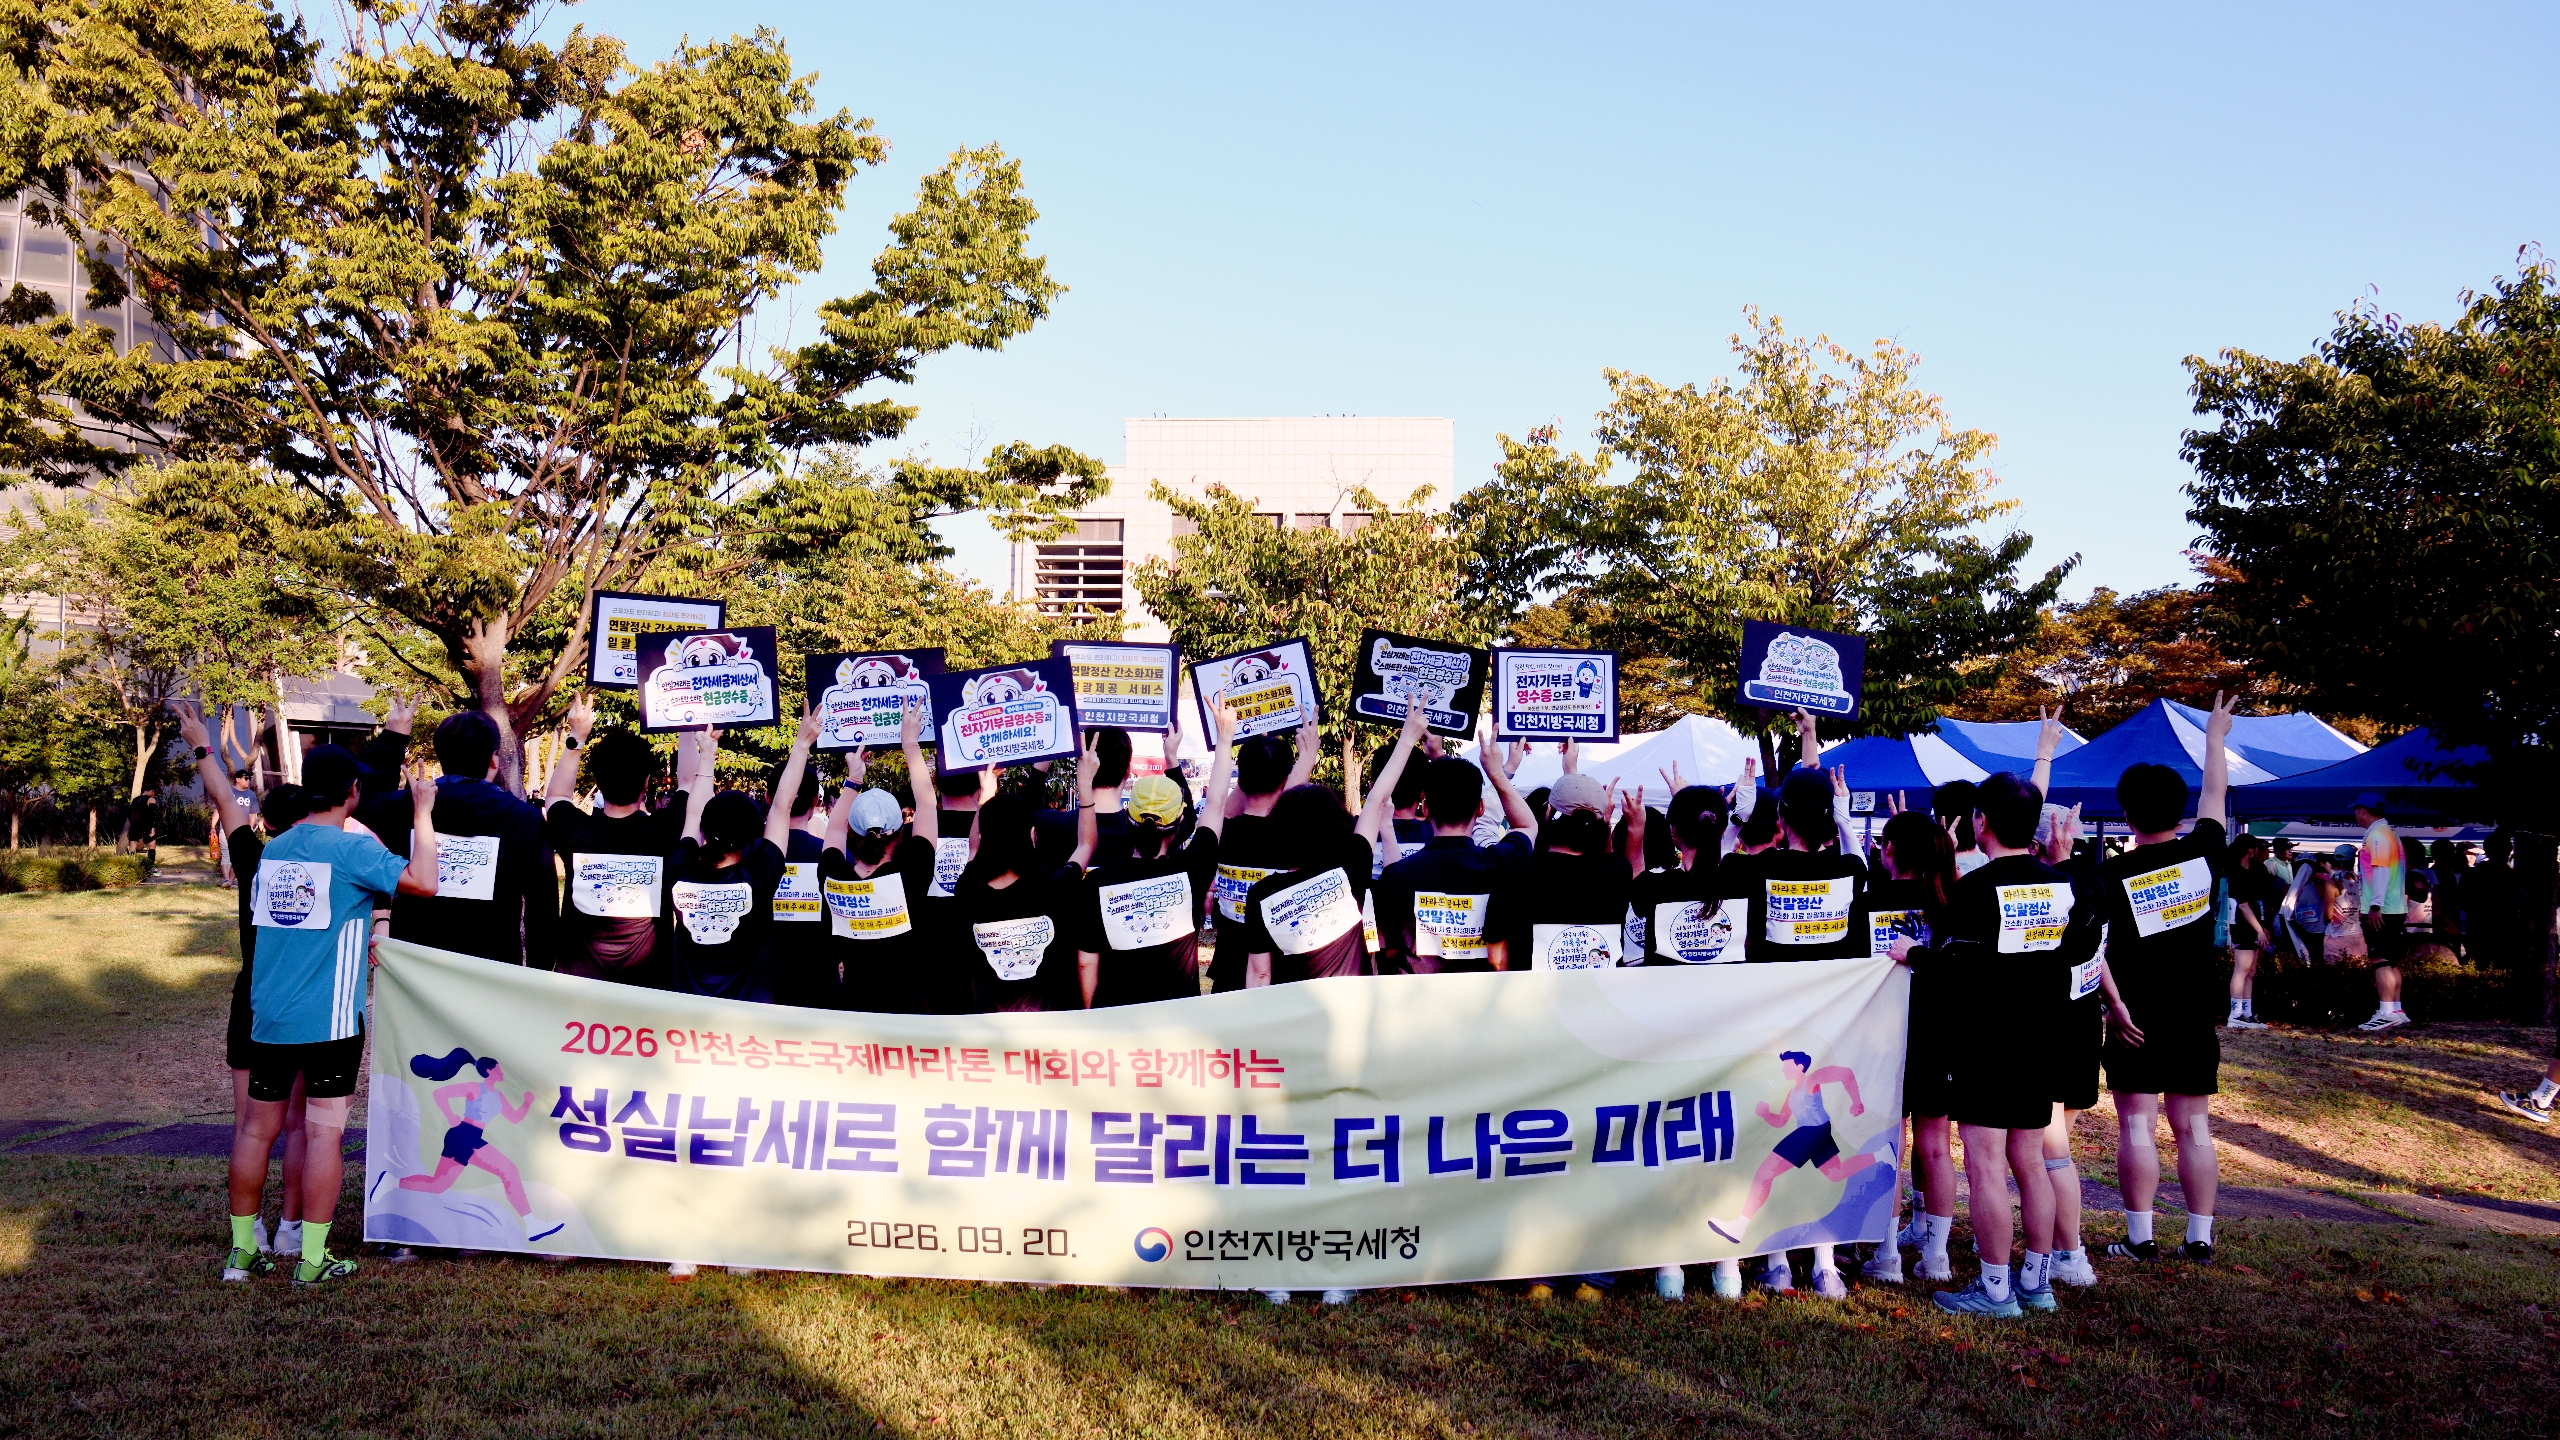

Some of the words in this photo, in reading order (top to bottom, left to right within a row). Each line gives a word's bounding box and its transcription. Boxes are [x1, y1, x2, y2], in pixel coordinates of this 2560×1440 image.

[1380, 650, 1409, 661] 안심거래는
[1409, 650, 1470, 672] 전자세금계산서
[1071, 665, 1111, 678] 연말정산
[1114, 666, 1164, 679] 간소화자료
[1378, 663, 1401, 672] 스마트한
[1418, 665, 1463, 685] 현금영수증
[662, 680, 691, 691] 안심거래는
[691, 673, 758, 691] 전자세금계산서
[1128, 684, 1164, 695] 서비스
[1516, 674, 1573, 689] 전자기부금
[703, 689, 749, 706] 현금영수증
[1256, 686, 1293, 702] 간소화자료
[1516, 688, 1576, 705] 영수증으로!
[1774, 689, 1837, 708] 인천지방국세청
[830, 700, 861, 711] 안심거래는
[1085, 711, 1159, 724] 인천지방국세청
[1386, 703, 1452, 725] 인천국세청
[1513, 713, 1599, 731] 인천지방국세청
[960, 711, 1053, 738] 전자기부금영수증과
[979, 725, 1037, 748] 함께하세요!
[987, 739, 1045, 758] 인천지방국세청
[1132, 763, 1149, 771] SINCE
[1218, 867, 1237, 878] 마라톤
[1771, 884, 1799, 894] 마라톤
[2129, 875, 2154, 888] 마라톤
[269, 890, 294, 901] 전자기부금
[826, 892, 871, 909] 연말정산
[2003, 889, 2028, 899] 마라톤
[2131, 881, 2180, 905] 연말정산
[1769, 895, 1824, 911] 연말정산
[2003, 900, 2052, 918] 연말정산
[1769, 910, 1790, 920] 간소화
[1791, 912, 1805, 920] 자료
[2004, 919, 2023, 928] 간소화
[1674, 928, 1709, 941] 전자기부금
[1678, 938, 1711, 949] 영수증에!
[1552, 953, 1588, 965] 전자기부금
[560, 1020, 659, 1061] 2026
[665, 1027, 996, 1083] 인천송도국제마라톤
[1003, 1048, 1117, 1087] 대회와
[1130, 1048, 1286, 1089] 함께하는
[549, 1085, 900, 1174] 성실납세로
[922, 1102, 1068, 1182] 함께
[1091, 1112, 1311, 1187] 달리는
[1332, 1114, 1402, 1184] 더
[1427, 1109, 1575, 1181] 나은
[1591, 1090, 1736, 1168] 미래
[846, 1219, 948, 1252] 2026.
[958, 1224, 1013, 1255] 09.
[1022, 1227, 1079, 1258] 20.
[1184, 1225, 1421, 1263] 인천지방국세청
